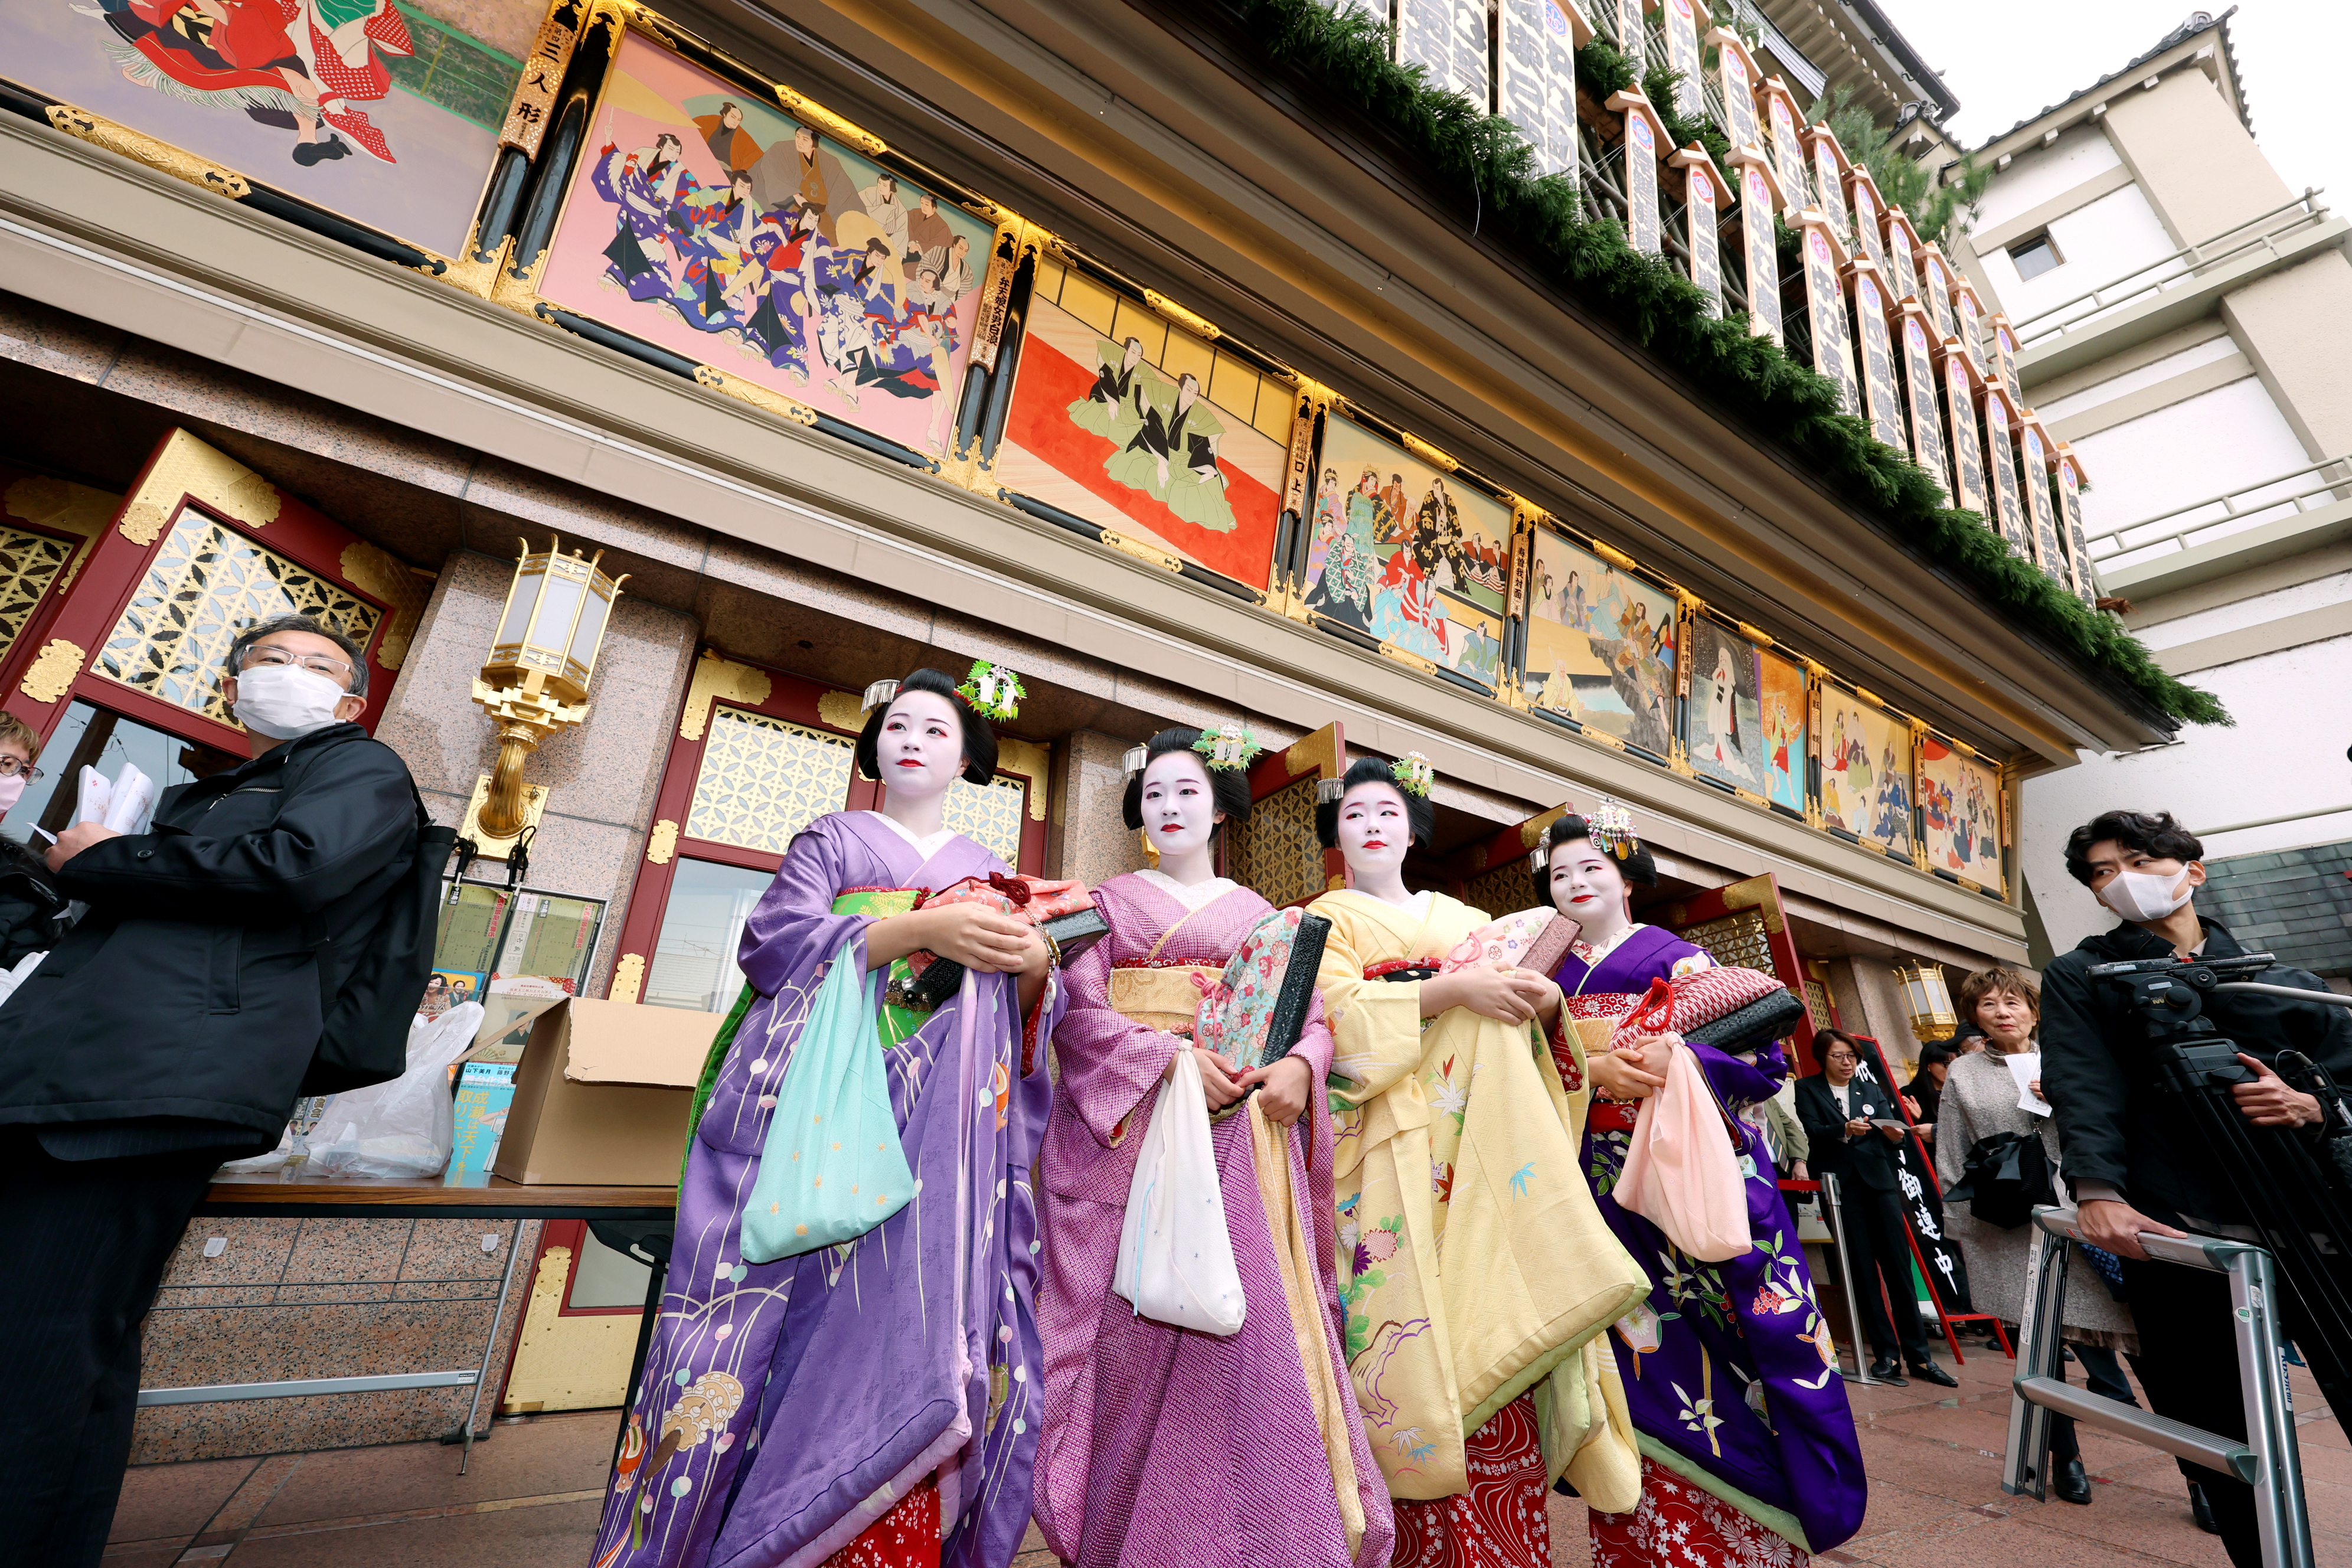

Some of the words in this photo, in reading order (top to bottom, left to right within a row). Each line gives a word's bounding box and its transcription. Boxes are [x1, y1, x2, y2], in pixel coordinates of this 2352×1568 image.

[551, 26, 563, 43] 第四
[515, 40, 562, 123] 三人形
[998, 261, 1007, 275] 第三
[986, 276, 1010, 347] 弁天娘女男白浪
[1291, 459, 1305, 494] 口上
[1514, 547, 1526, 600] 寿曽我対面
[456, 1091, 490, 1171] 成瀬は天下を
